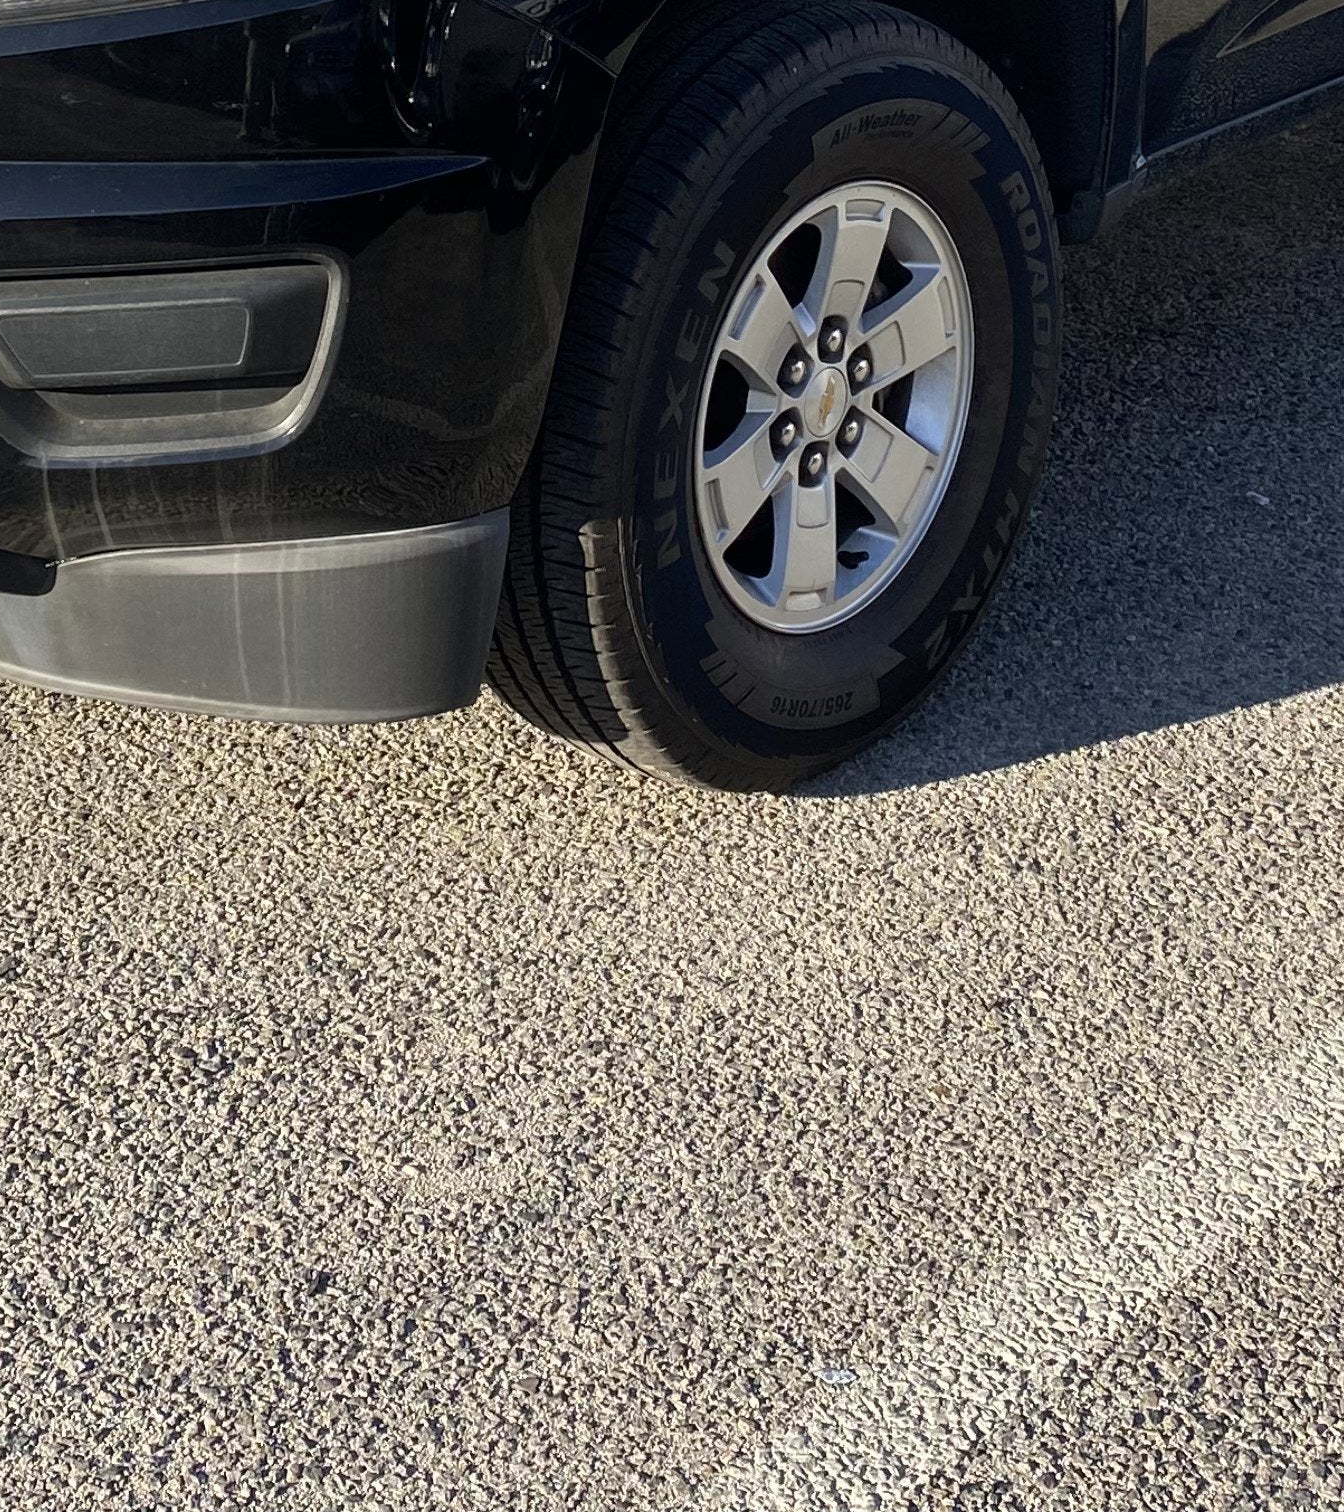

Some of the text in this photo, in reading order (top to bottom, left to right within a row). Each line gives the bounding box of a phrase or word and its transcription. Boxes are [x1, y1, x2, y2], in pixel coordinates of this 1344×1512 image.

[829, 108, 923, 150] All-Weather
[653, 239, 738, 570] NEXEN
[769, 690, 855, 718] 265/70R16
